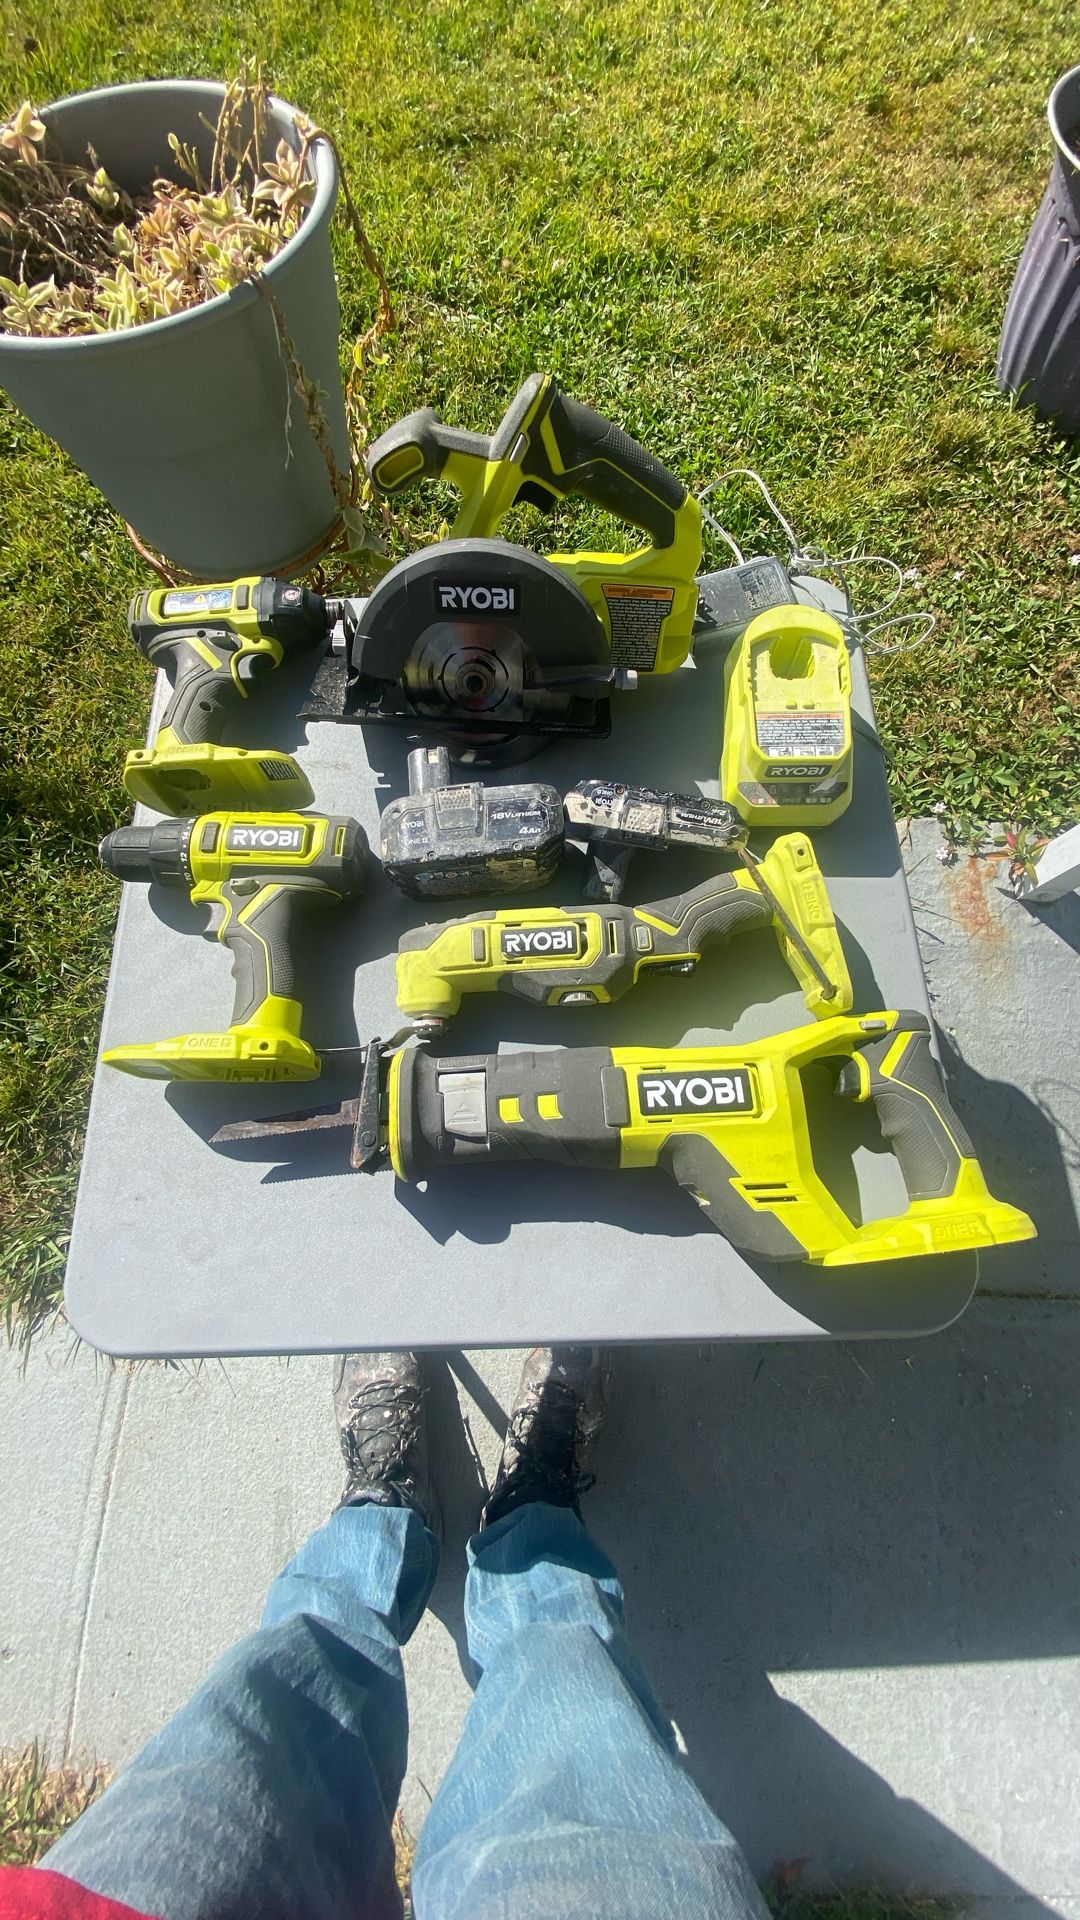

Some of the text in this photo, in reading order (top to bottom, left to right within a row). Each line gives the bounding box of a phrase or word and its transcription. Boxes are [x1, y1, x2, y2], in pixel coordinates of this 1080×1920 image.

[439, 586, 515, 610] RYOBI
[771, 767, 826, 776] RYOBI
[232, 829, 300, 847] RYOBI
[180, 851, 188, 863] 12
[504, 930, 573, 953] RYOBI
[642, 1076, 745, 1108] RYOBI
